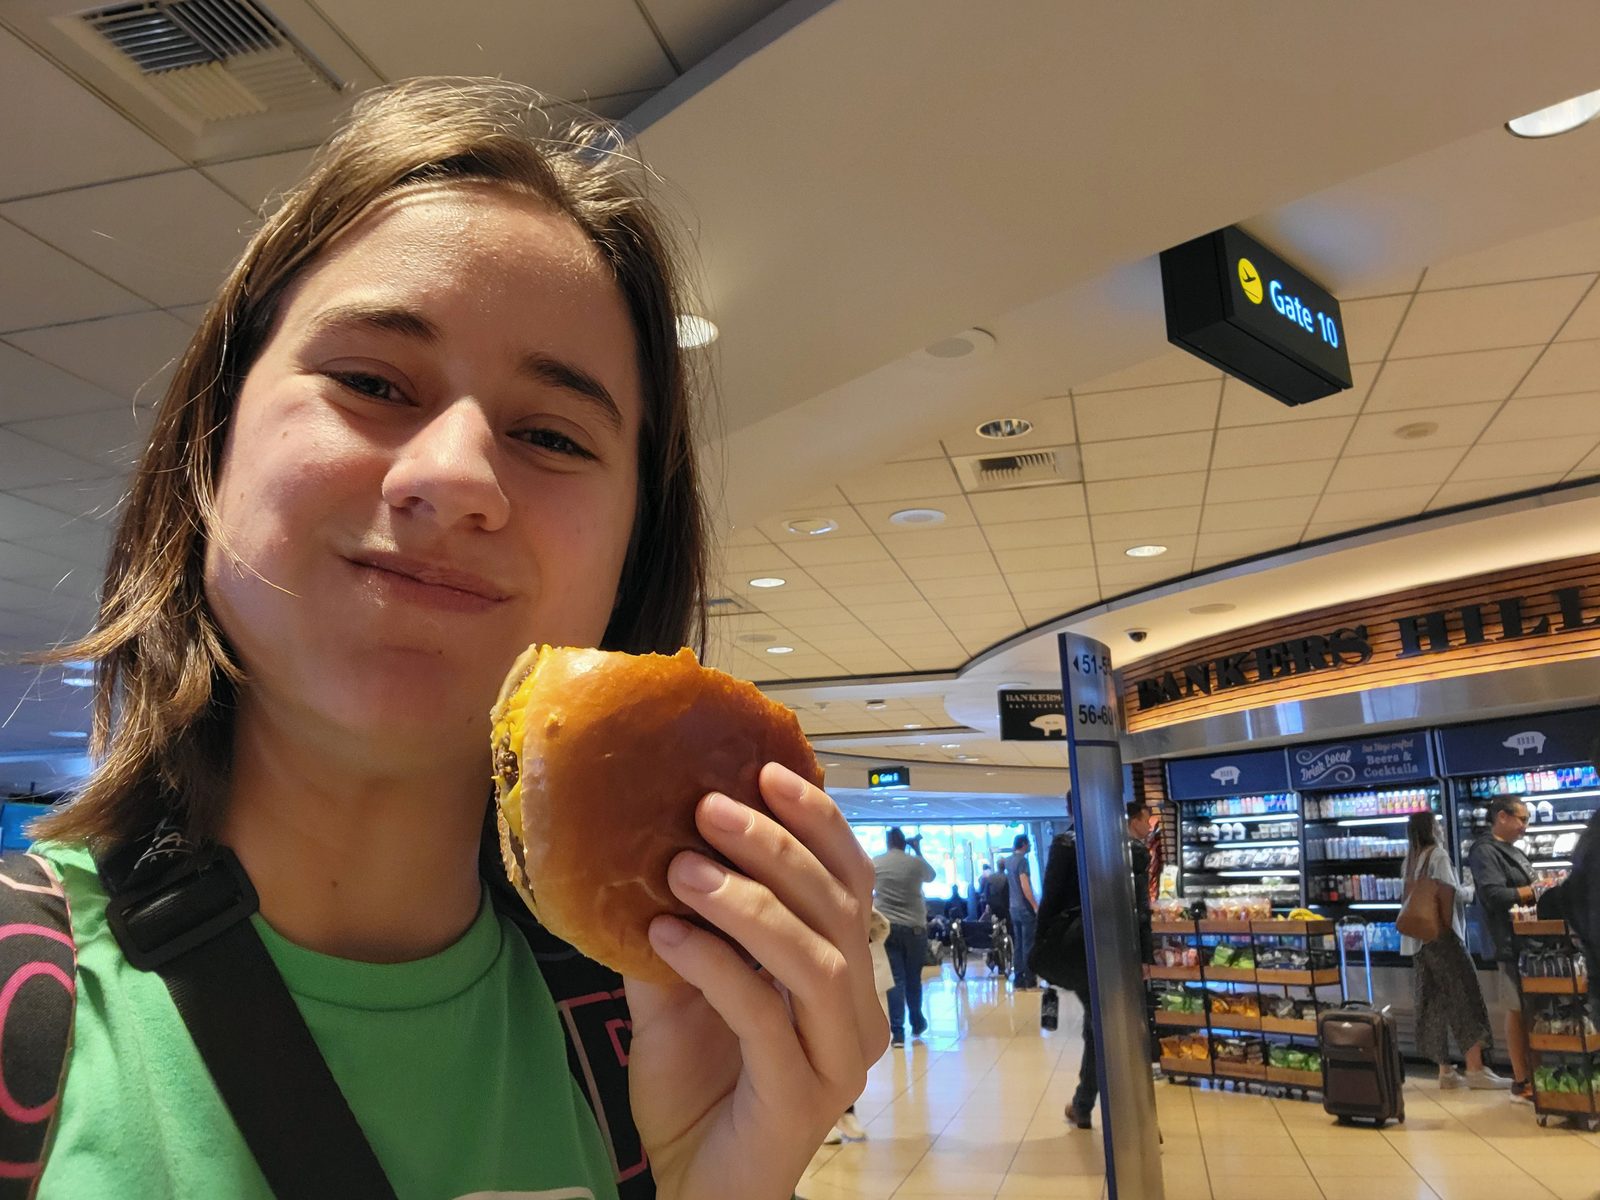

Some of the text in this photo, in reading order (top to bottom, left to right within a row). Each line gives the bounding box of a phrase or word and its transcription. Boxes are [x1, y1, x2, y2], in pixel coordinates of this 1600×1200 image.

[1269, 280, 1339, 349] Gate 10
[1134, 624, 1376, 712] BANKERS
[1300, 749, 1352, 781] Drink Local
[1363, 763, 1419, 778] Cocktails
[1366, 751, 1413, 765] Beers &
